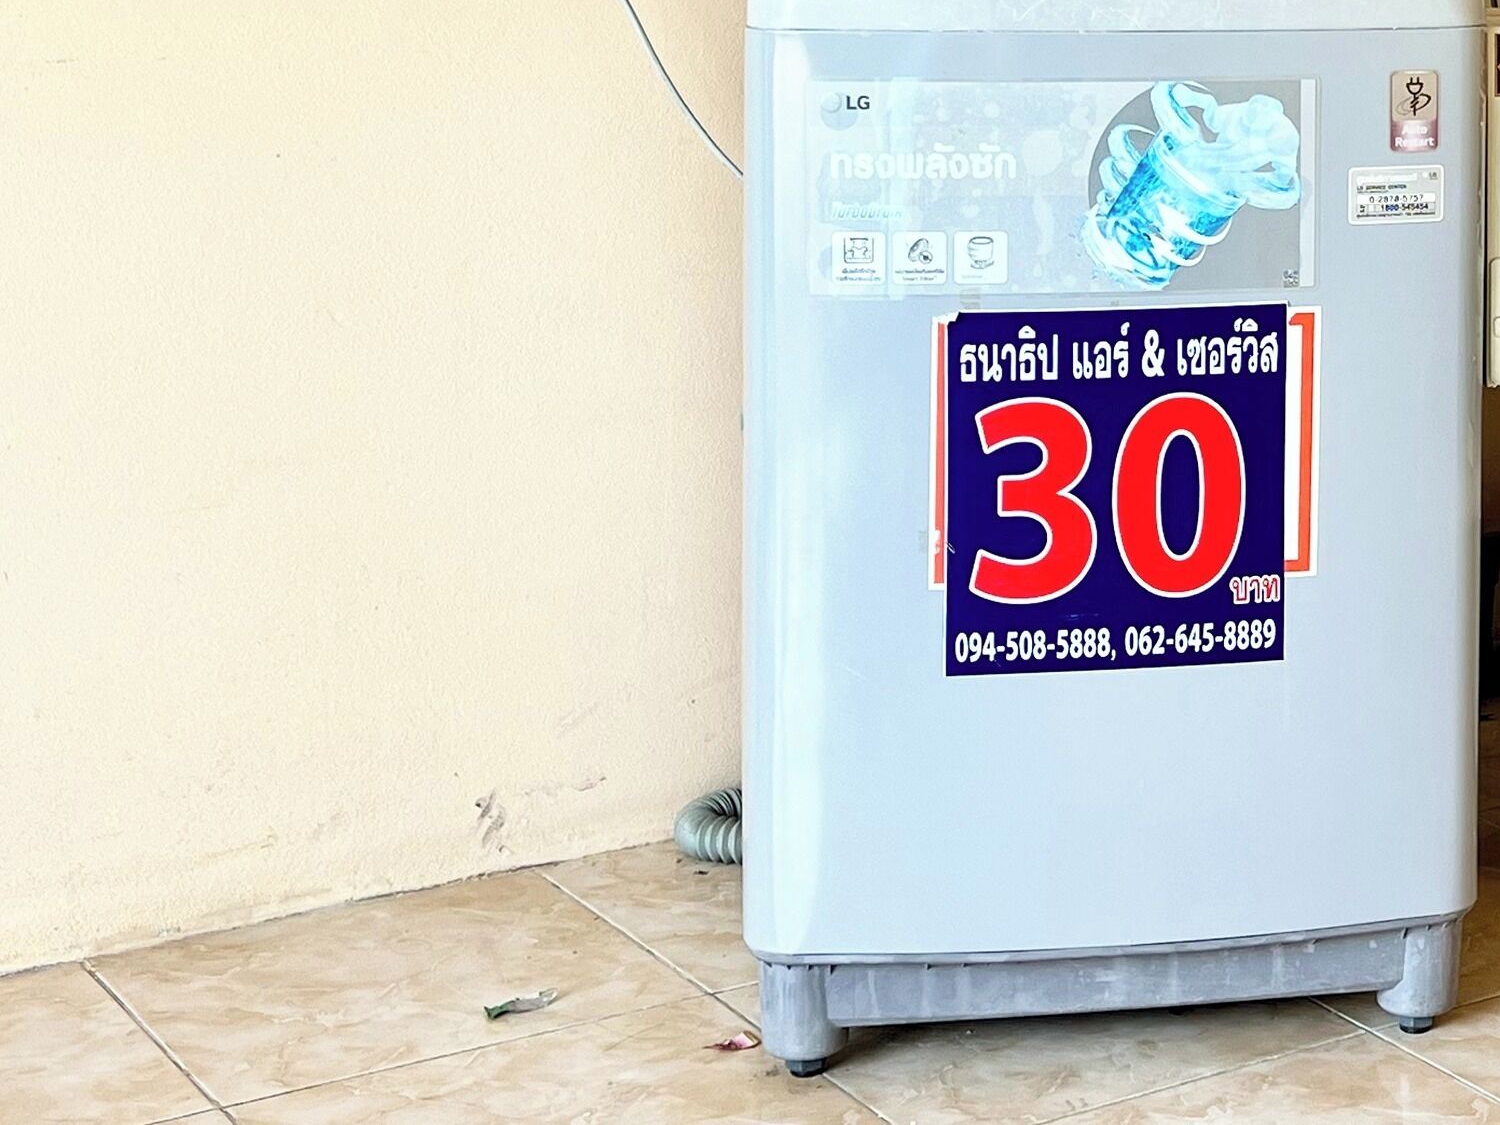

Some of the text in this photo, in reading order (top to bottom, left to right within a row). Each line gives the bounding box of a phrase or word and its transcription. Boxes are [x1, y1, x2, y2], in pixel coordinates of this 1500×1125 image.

[845, 95, 871, 111] LG
[958, 317, 1280, 382] ธนาธิป แอร์ & เซอร์วิส
[968, 391, 1247, 605] 30
[1229, 573, 1281, 605] บาท
[955, 618, 1277, 663] 094-508-5888, 062-645-8889
